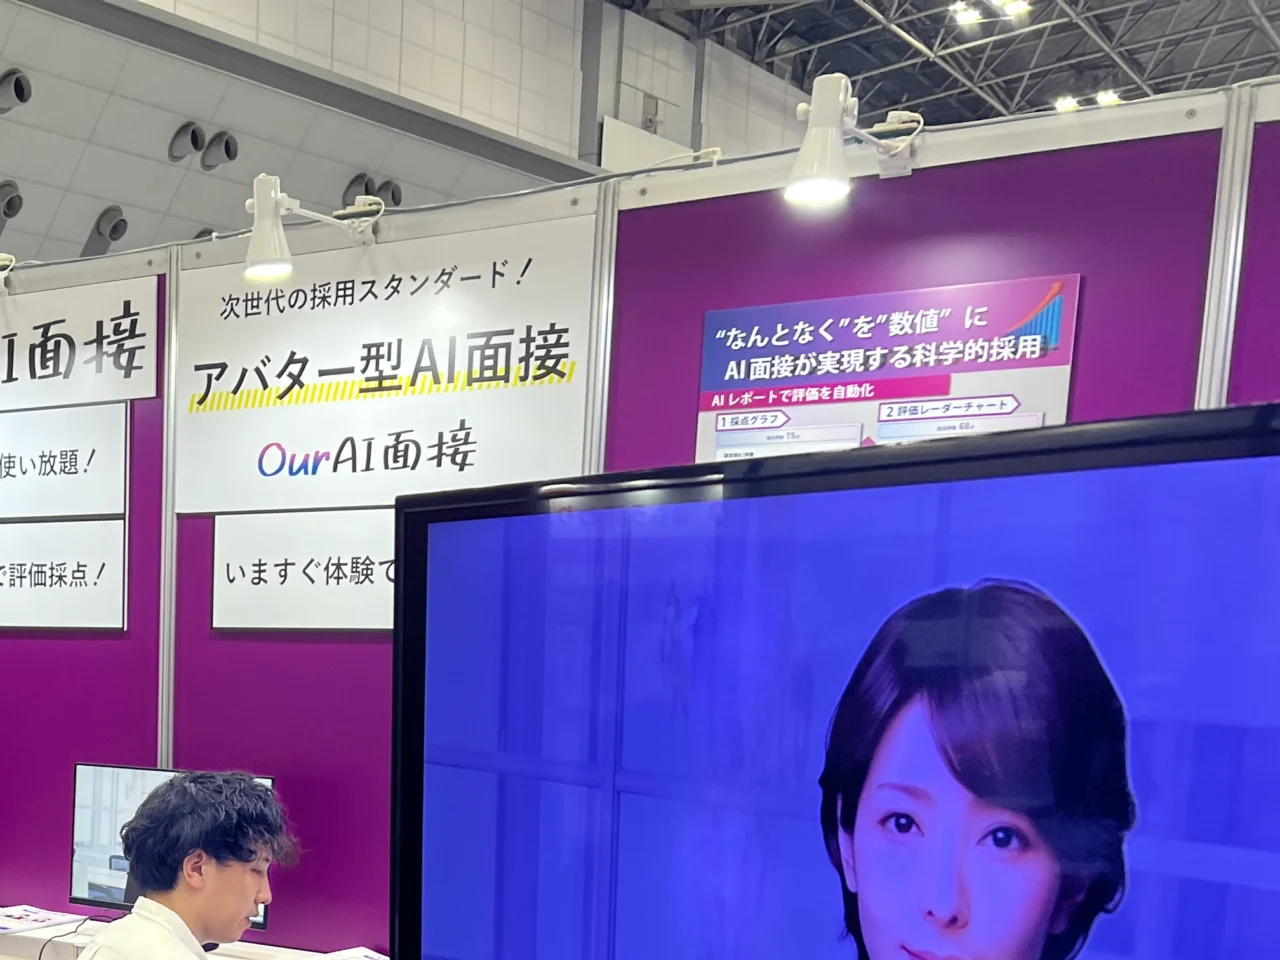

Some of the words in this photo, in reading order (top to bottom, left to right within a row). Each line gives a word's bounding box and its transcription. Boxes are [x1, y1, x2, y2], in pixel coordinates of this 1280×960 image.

[219, 256, 534, 321] 次世代の採用スタンダード！
[193, 320, 572, 406] アバター型AI面接
[257, 418, 478, 477] OurAI面接
